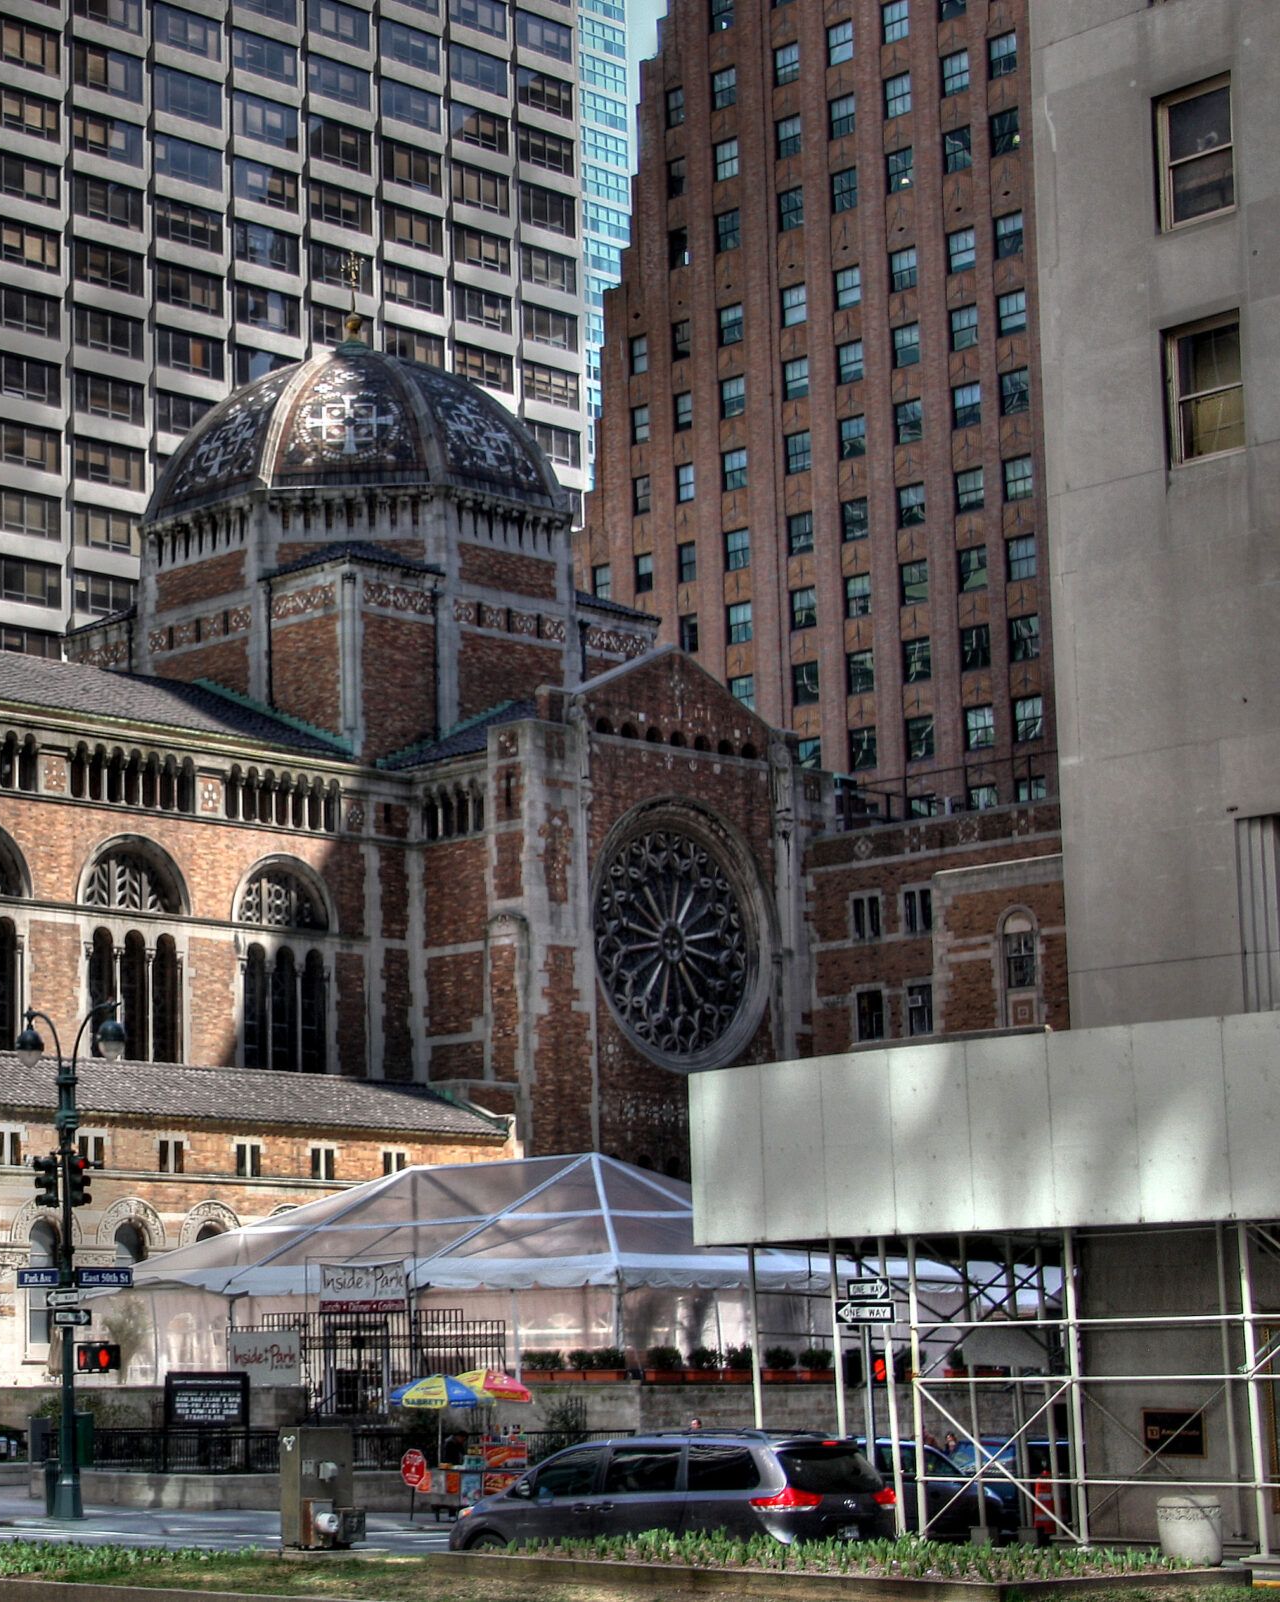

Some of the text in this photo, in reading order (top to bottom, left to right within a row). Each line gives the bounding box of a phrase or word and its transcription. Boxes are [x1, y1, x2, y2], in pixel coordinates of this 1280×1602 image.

[23, 1273, 52, 1283] Park Ave
[82, 1272, 129, 1283] East 50th St
[323, 1266, 403, 1298] Inside Park
[852, 1285, 883, 1294] ONE WAY
[843, 1308, 887, 1317] ONE WAY
[233, 1344, 296, 1371] Inside Park
[406, 1453, 423, 1465] STOP
